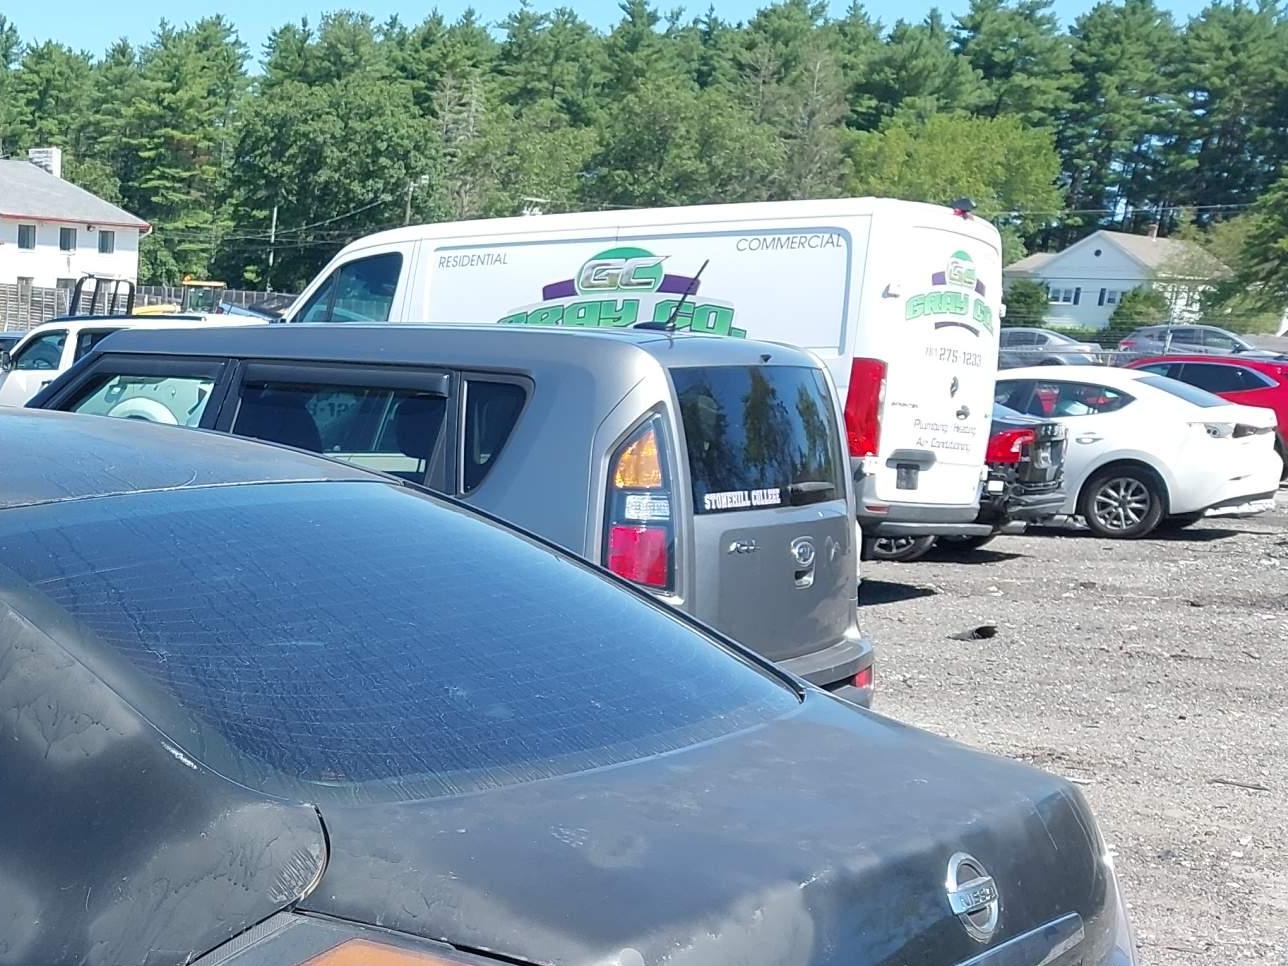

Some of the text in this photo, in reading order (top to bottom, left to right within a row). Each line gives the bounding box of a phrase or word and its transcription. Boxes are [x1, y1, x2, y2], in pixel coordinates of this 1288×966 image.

[736, 233, 843, 251] COMMERCIAL
[438, 252, 508, 268] RESIDENTIAL
[579, 255, 672, 290] GC
[905, 291, 969, 320] GRAY
[704, 488, 781, 510] STONEHILL COLLEGE
